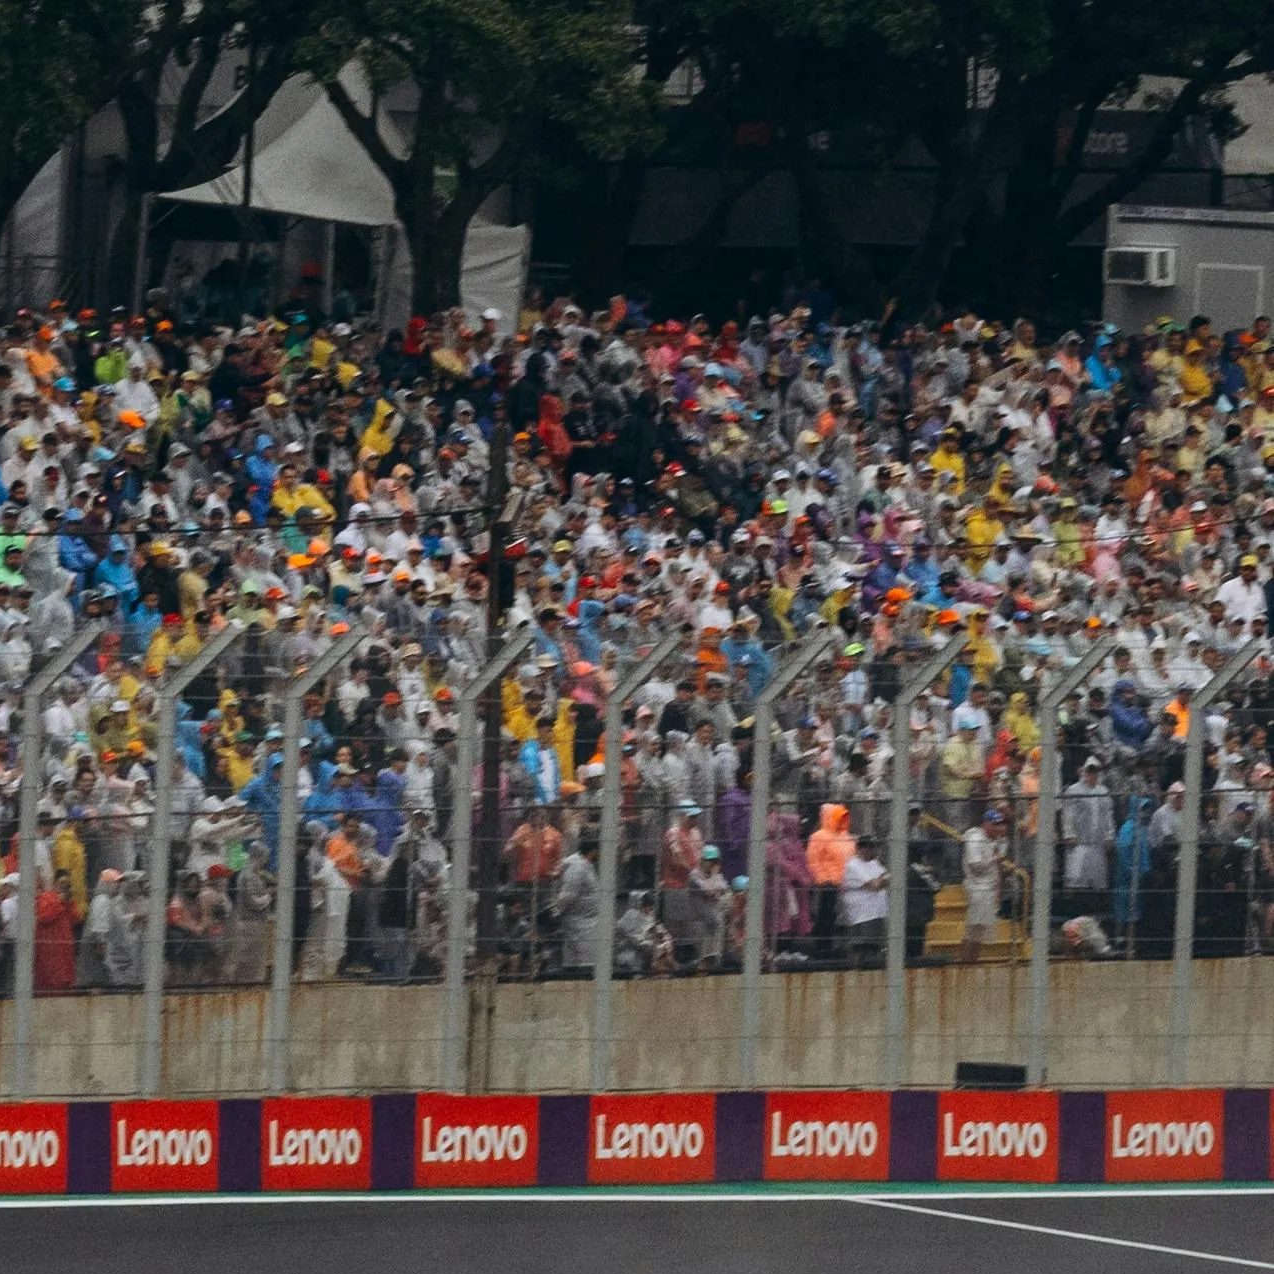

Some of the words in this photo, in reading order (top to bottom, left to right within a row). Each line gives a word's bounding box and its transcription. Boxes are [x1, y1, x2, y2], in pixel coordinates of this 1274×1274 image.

[117, 1119, 213, 1167] Lenovo
[268, 1119, 362, 1167] Lenovo
[421, 1116, 528, 1163] Lenovo
[595, 1113, 705, 1160] Lenovo
[770, 1110, 879, 1158] Lenovo
[943, 1112, 1048, 1159] Lenovo
[1111, 1113, 1215, 1159] Lenovo
